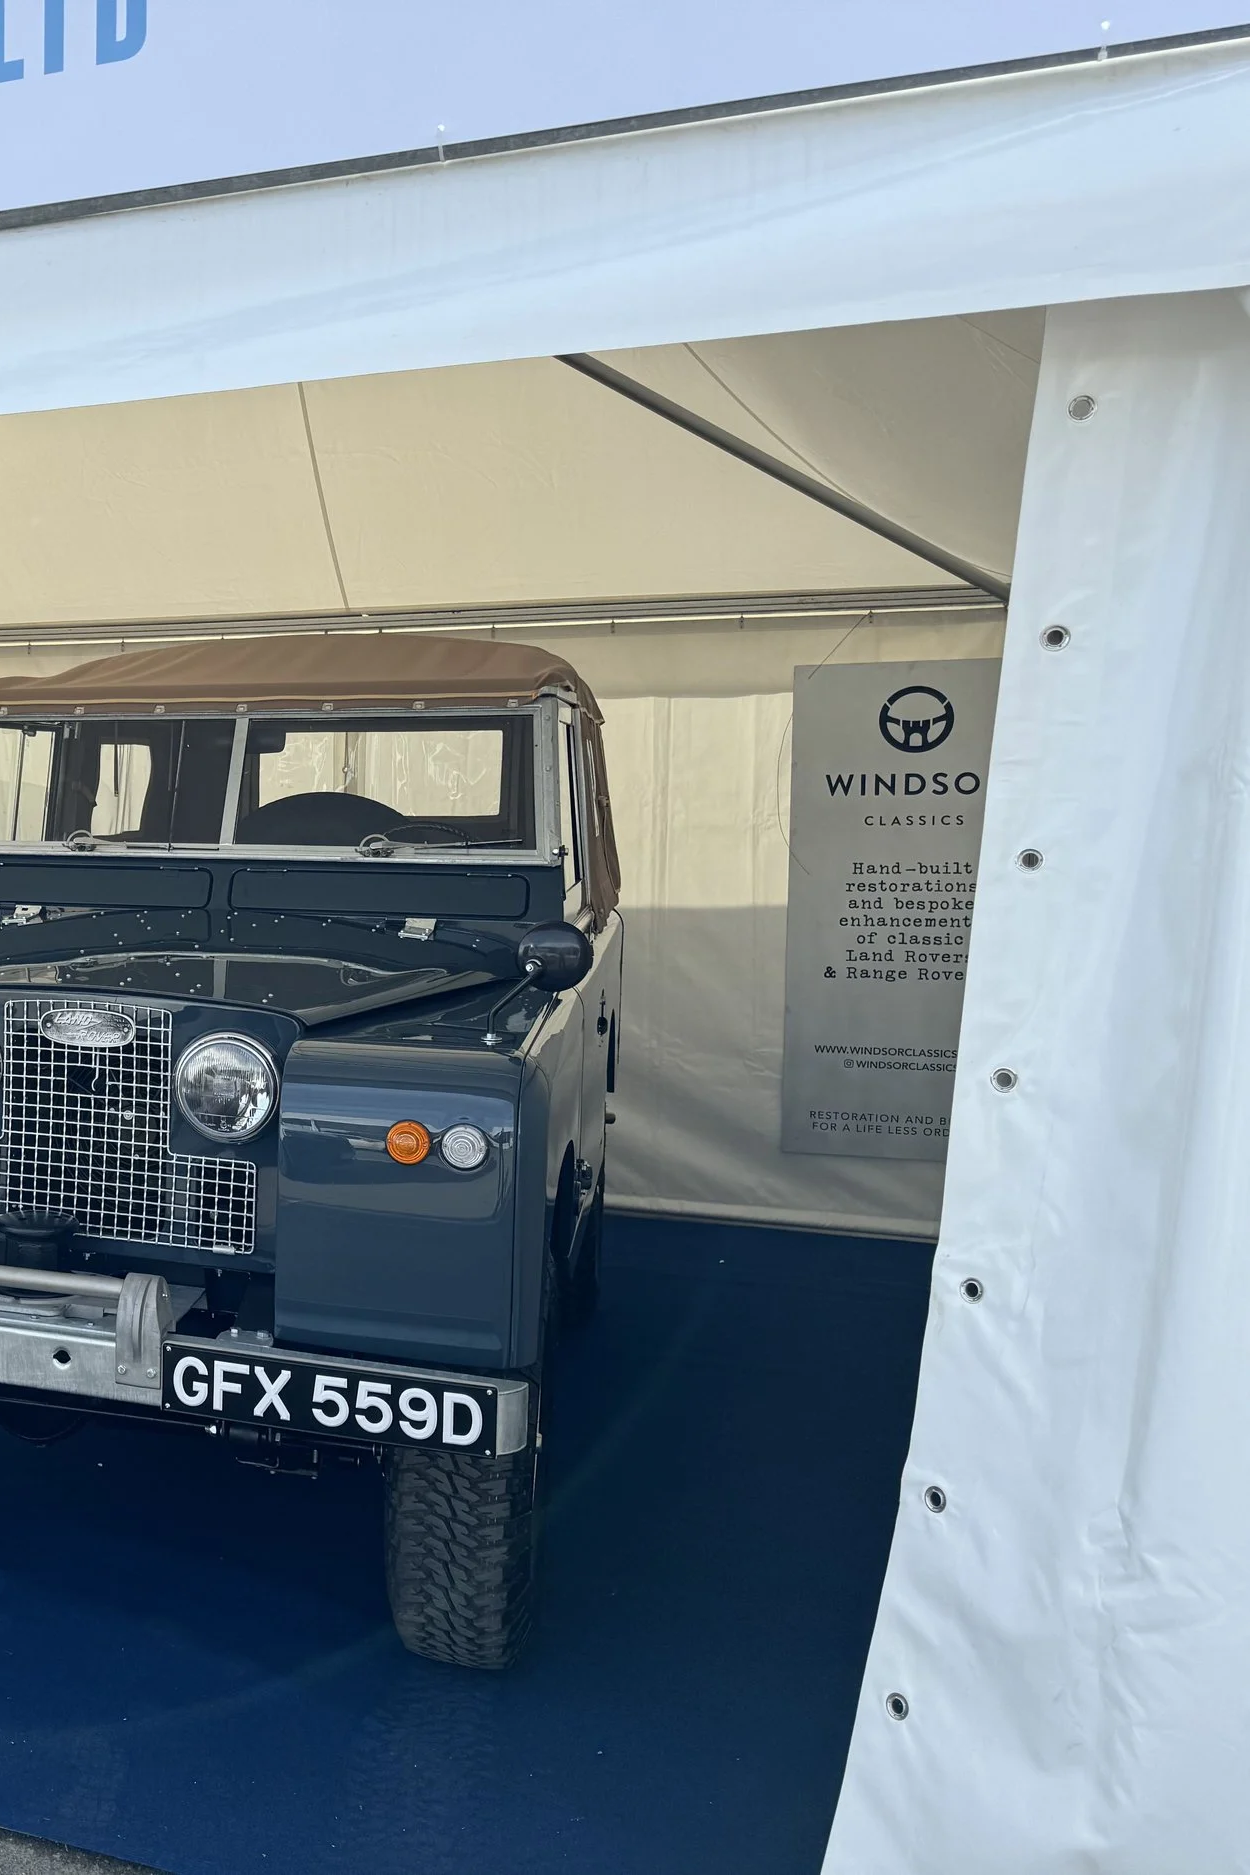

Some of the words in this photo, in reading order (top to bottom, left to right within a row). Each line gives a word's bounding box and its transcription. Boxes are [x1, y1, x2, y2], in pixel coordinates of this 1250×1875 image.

[825, 771, 981, 797] WINDSO
[864, 815, 964, 826] CLASSICS
[852, 862, 973, 875] Hand-built
[845, 880, 976, 893] restorations
[848, 897, 883, 910] and
[893, 897, 974, 913] bespoke
[839, 915, 972, 928] enhancement
[856, 932, 877, 944] of
[887, 932, 964, 946] classic
[846, 949, 894, 962] Land
[824, 966, 836, 979] &
[846, 966, 907, 982] Range
[917, 968, 964, 981] Rove
[53, 1012, 93, 1026] LAND
[76, 1029, 120, 1043] ROVER
[814, 1044, 958, 1059] WWW.WINDSORCLASSICS
[809, 1110, 899, 1123] RESTORATION
[905, 1115, 933, 1125] AND
[812, 1122, 837, 1132] FOR
[842, 1124, 851, 1132] A
[856, 1124, 882, 1134] LIFE
[888, 1125, 917, 1136] LESS
[172, 1355, 292, 1421] GFX
[311, 1374, 483, 1447] 559D
